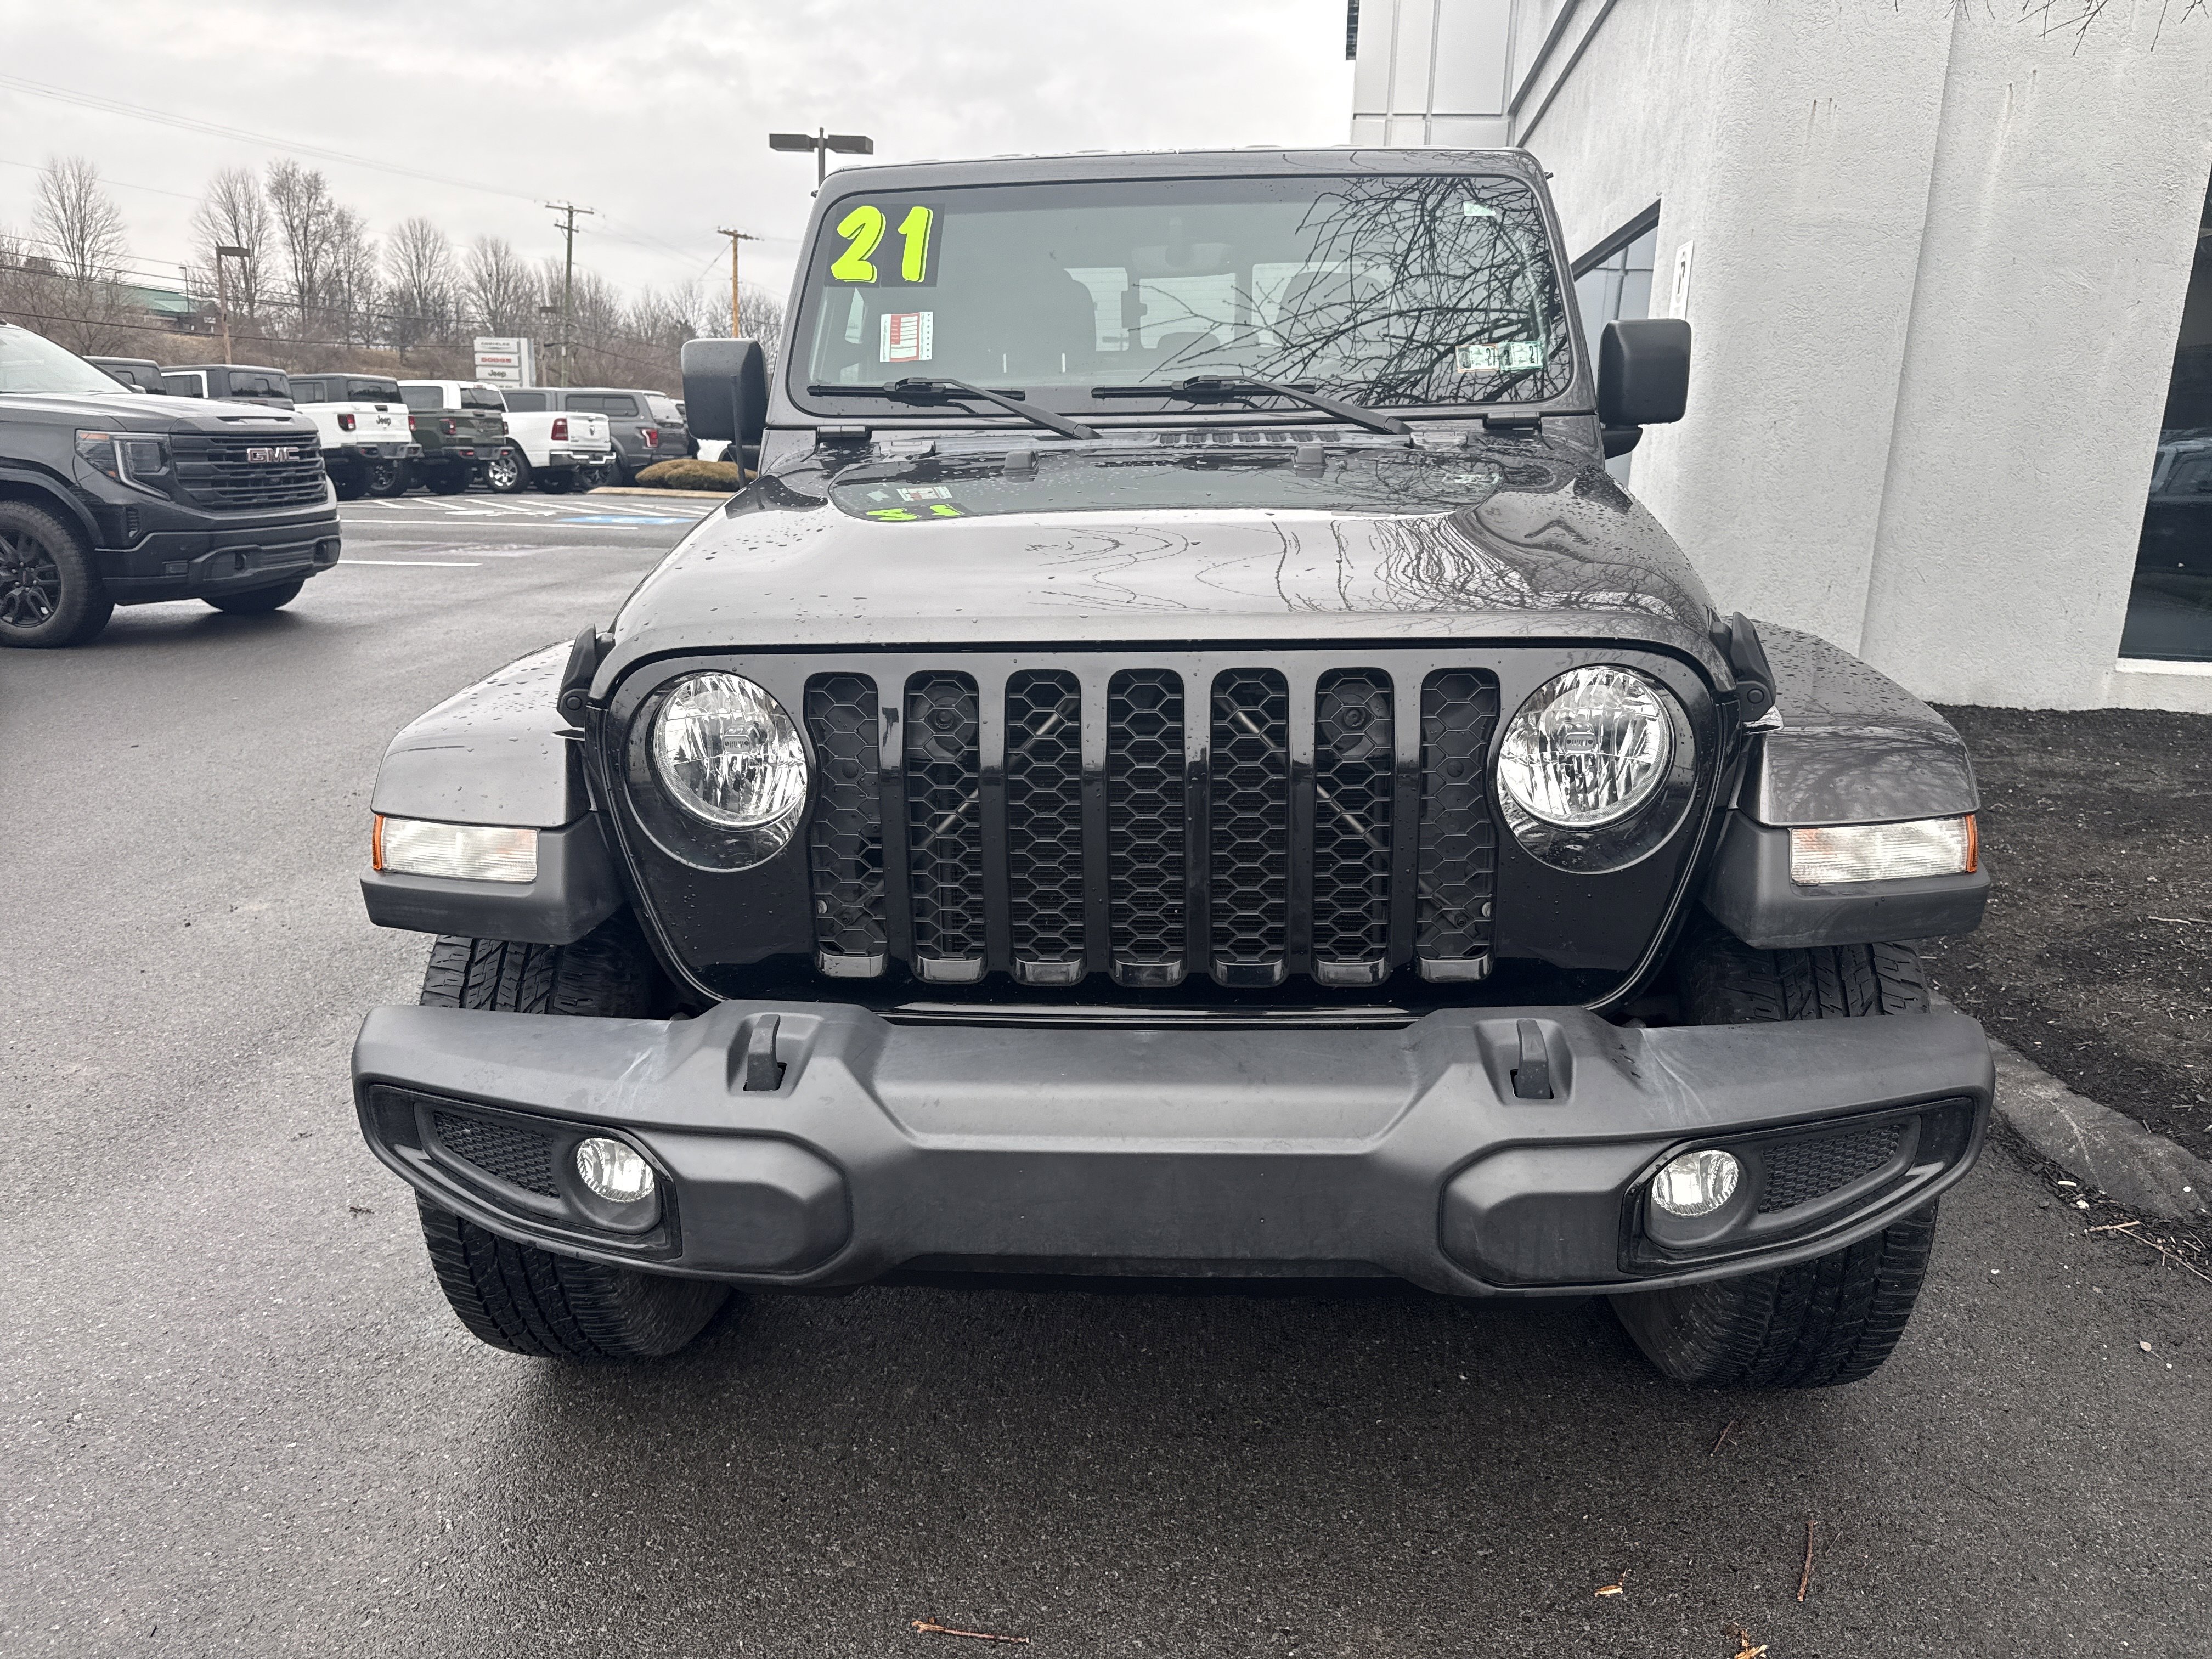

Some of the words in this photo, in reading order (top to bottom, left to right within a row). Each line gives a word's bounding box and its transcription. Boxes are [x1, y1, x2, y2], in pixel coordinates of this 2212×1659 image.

[831, 205, 934, 284] 21
[488, 369, 507, 379] Jeep
[376, 415, 392, 426] Jeep
[246, 446, 300, 464] GMC
